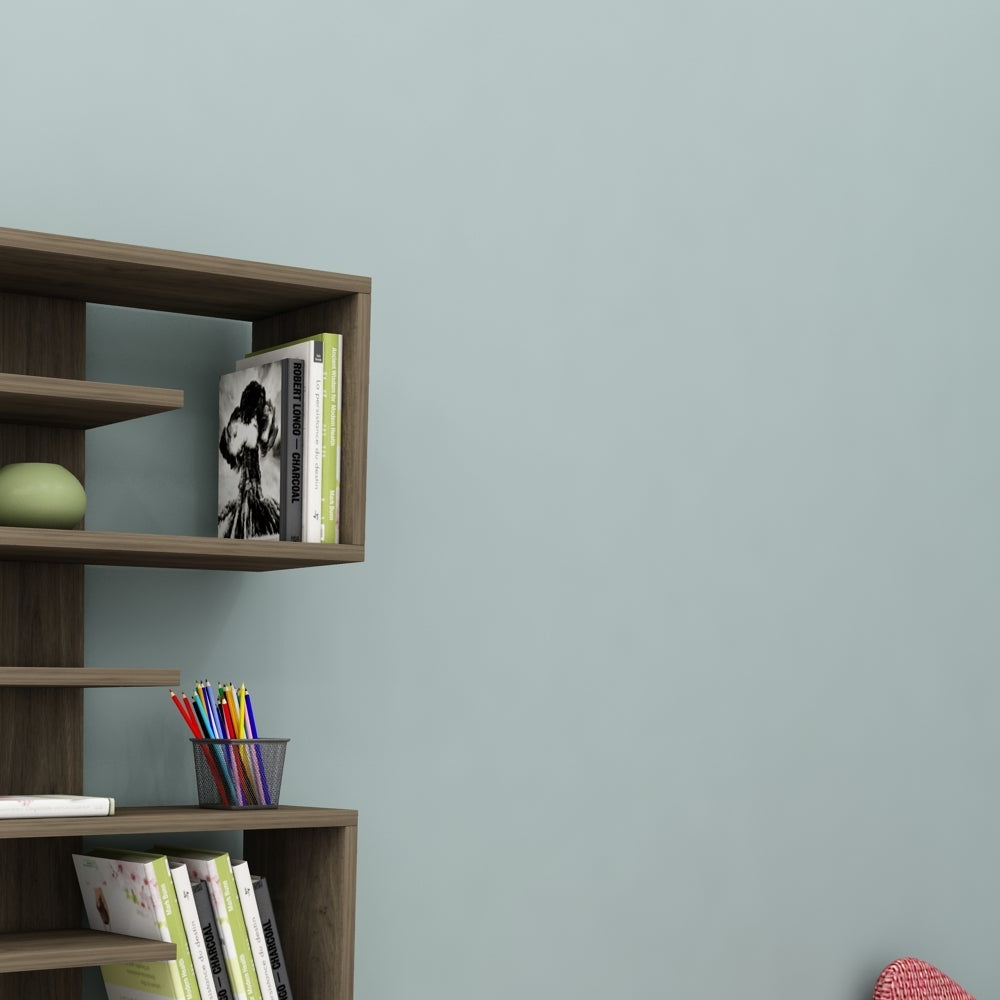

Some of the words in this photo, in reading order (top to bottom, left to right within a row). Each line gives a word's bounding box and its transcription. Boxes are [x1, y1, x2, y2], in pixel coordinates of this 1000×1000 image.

[293, 362, 302, 402] ROBERT
[292, 404, 301, 436] LONGO
[291, 452, 300, 504] CHARCOAL
[191, 921, 200, 947] destin
[252, 916, 261, 943] destin
[197, 950, 204, 962] du
[203, 923, 222, 975] CHARCOAL
[256, 945, 264, 957] du
[263, 919, 281, 970] CHARCOAL
[177, 958, 187, 978] Health
[238, 953, 248, 973] Health
[181, 977, 193, 999] Modern
[242, 972, 253, 994] Modern
